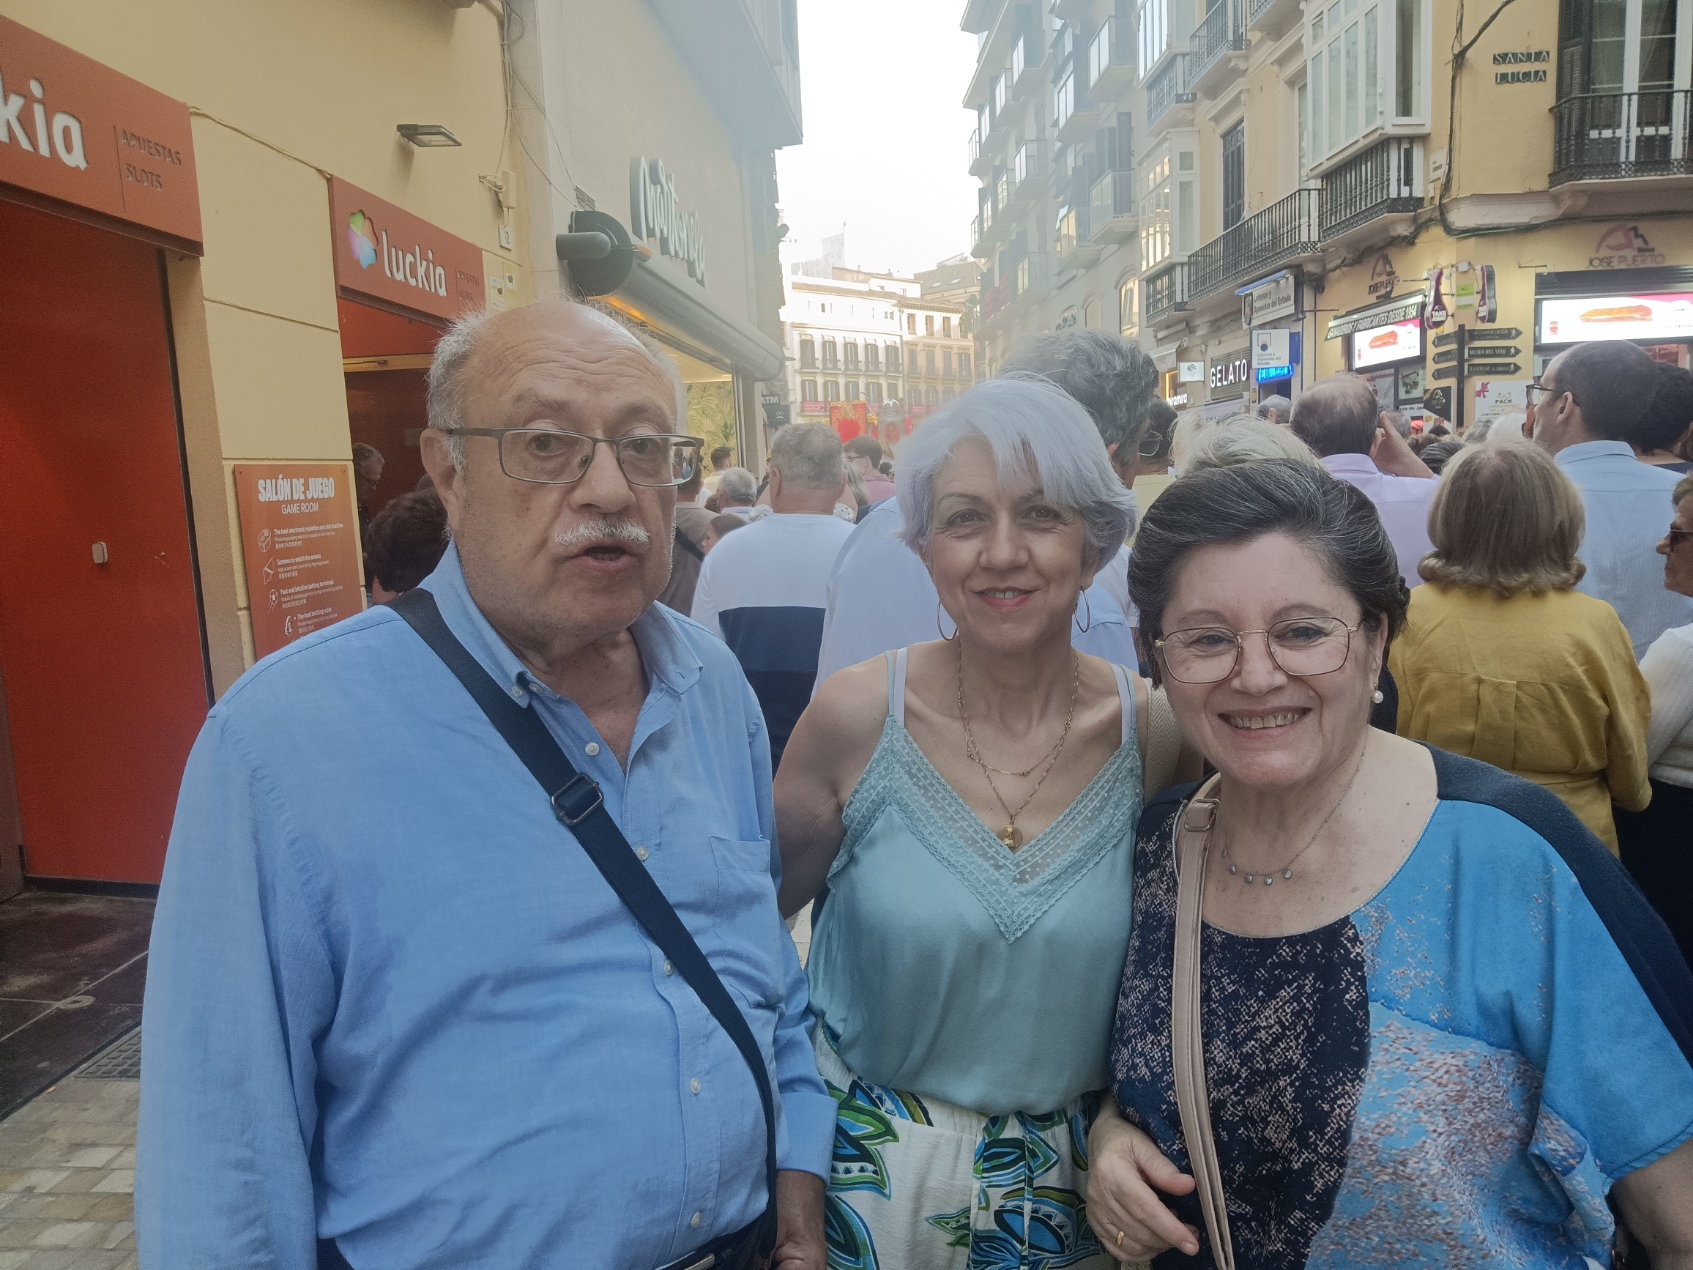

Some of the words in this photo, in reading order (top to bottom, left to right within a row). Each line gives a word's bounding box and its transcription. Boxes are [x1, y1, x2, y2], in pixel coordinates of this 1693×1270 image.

[121, 129, 182, 167] APUESTAS
[125, 162, 163, 191] SLOTS
[382, 230, 447, 297] luckia
[1210, 359, 1248, 388] GELATO
[257, 474, 292, 502] SALÓN
[292, 478, 305, 500] DE
[306, 477, 335, 500] JUEGO
[281, 503, 301, 515] GAME
[300, 501, 319, 513] ROOM
